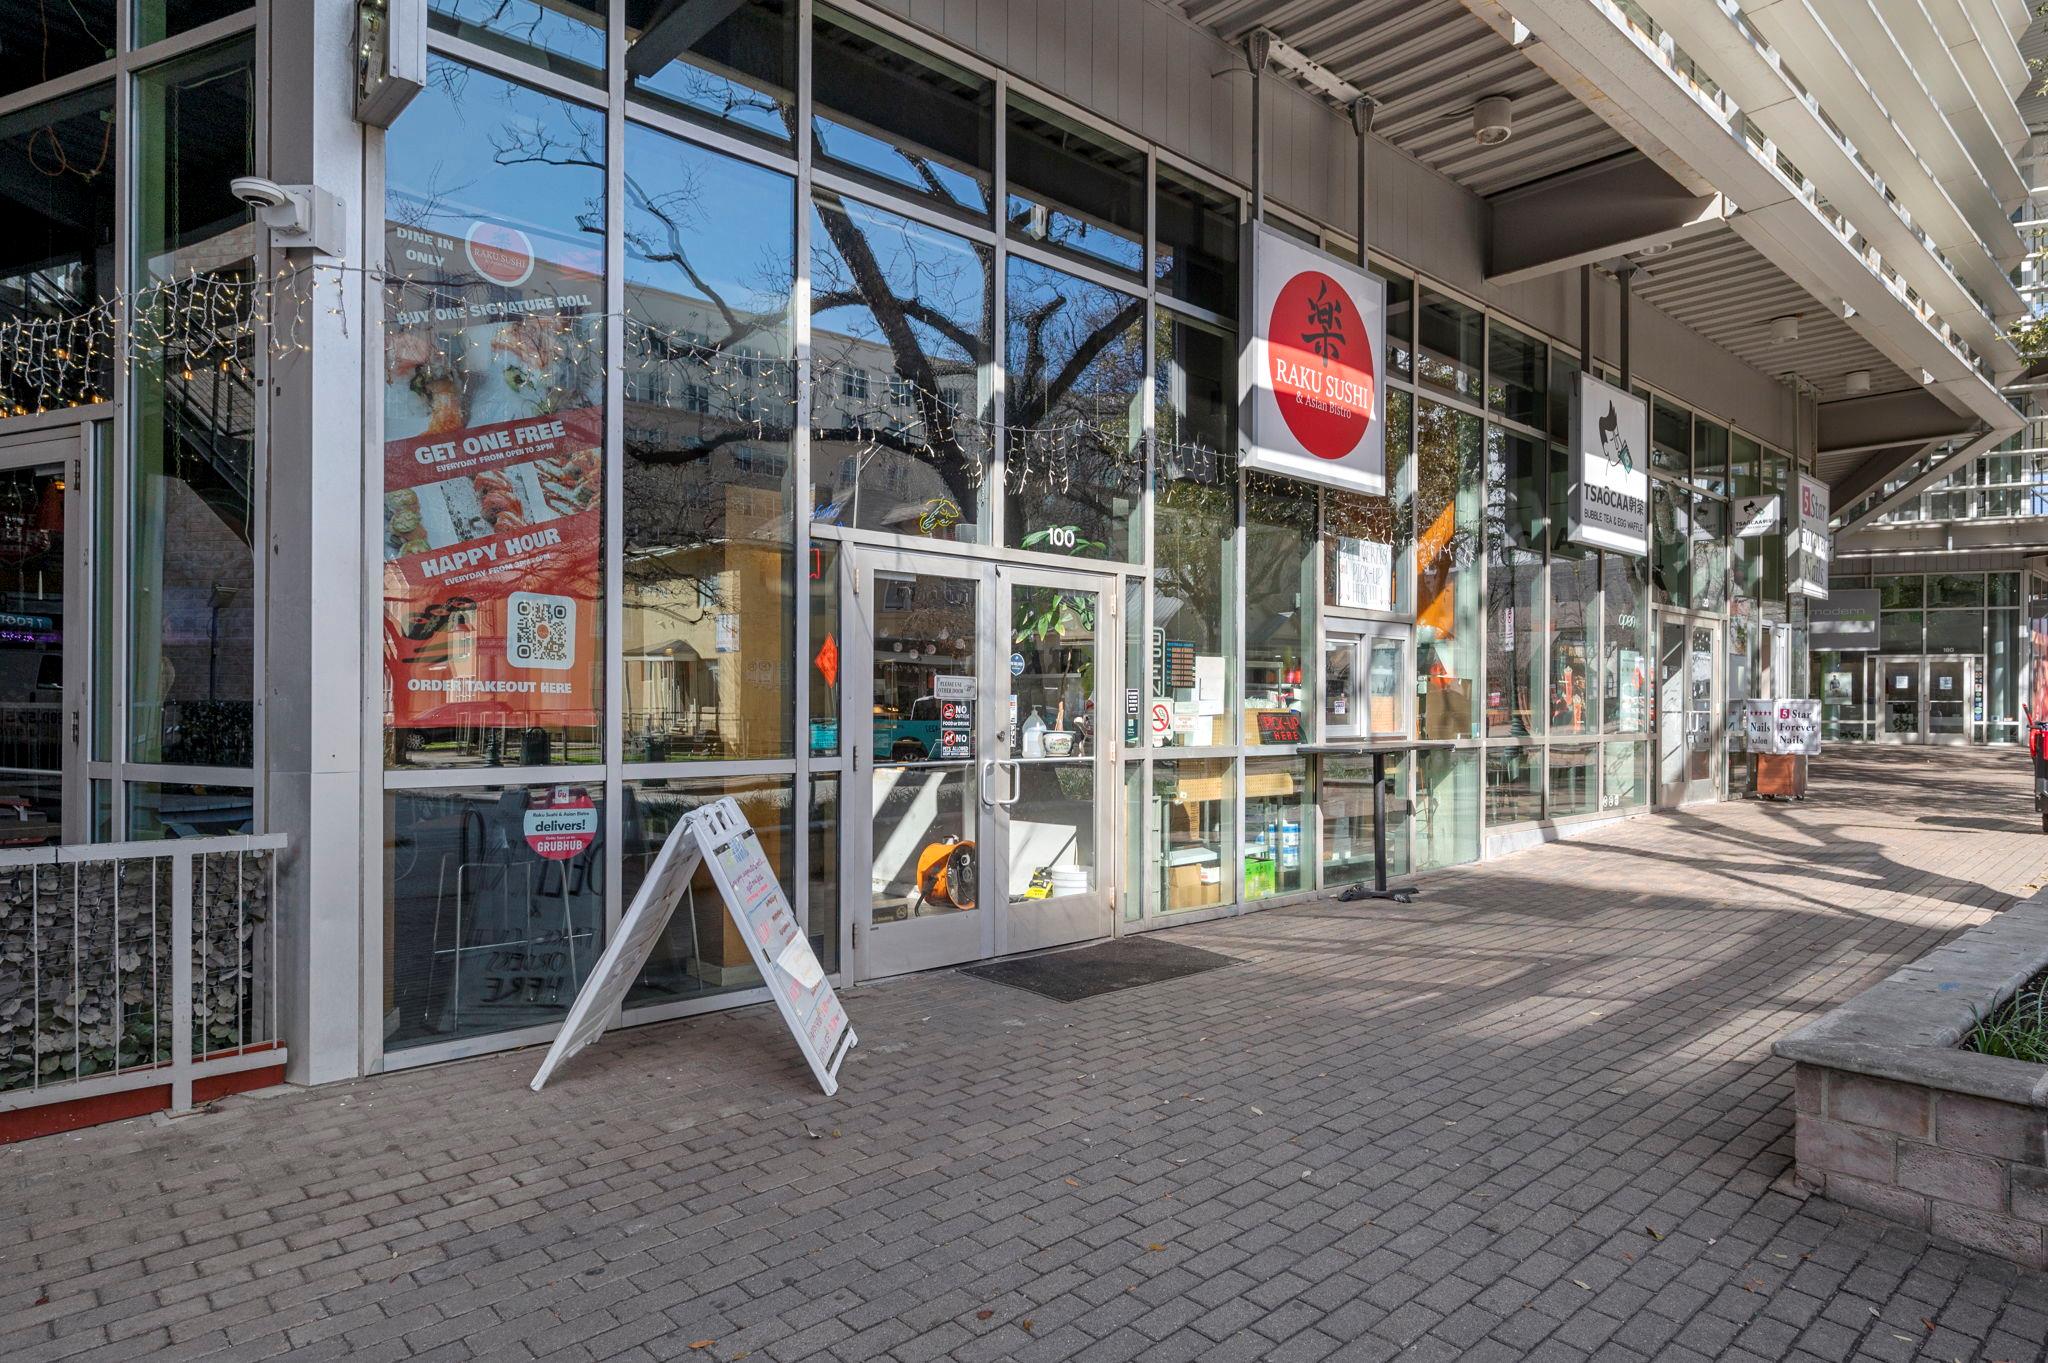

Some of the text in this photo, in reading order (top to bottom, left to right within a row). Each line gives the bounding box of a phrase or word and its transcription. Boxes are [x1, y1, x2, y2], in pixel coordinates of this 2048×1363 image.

[396, 227, 454, 251] DINE IN
[406, 249, 445, 268] ONLY
[474, 247, 500, 263] RAKU
[501, 253, 526, 269] SUSHI
[396, 294, 592, 325] BUY ONE SIGNATURE ROLL
[1276, 358, 1369, 409] RAKU SUSHI
[1295, 391, 1352, 420] & Asian Bistro
[415, 420, 566, 466] GET ONE FREE
[436, 442, 554, 473] EVERYDAY FROM OPEN TO 3PM
[1811, 493, 1827, 522] Star
[1584, 508, 1602, 522] BUBBLE
[1603, 513, 1613, 525] TEA
[1617, 516, 1627, 528] EGG
[1627, 521, 1643, 533] WAFFLE
[1047, 527, 1075, 548] 100
[420, 527, 562, 578] HAPPY HOUR
[444, 569, 487, 586] EVERYDAY
[488, 564, 514, 576] FROM
[1804, 554, 1825, 586] Nails
[408, 679, 573, 694] ORDER TAKEOUT HERE
[955, 705, 968, 714] NO
[1792, 710, 1811, 719] Star
[1273, 731, 1299, 741] HERE
[1750, 722, 1771, 733] Nails
[1780, 722, 1817, 732] Forever
[955, 734, 968, 743] NO
[1780, 736, 1804, 745] Nails
[535, 819, 586, 832] delivers!
[537, 840, 583, 852] GRUBHUB
